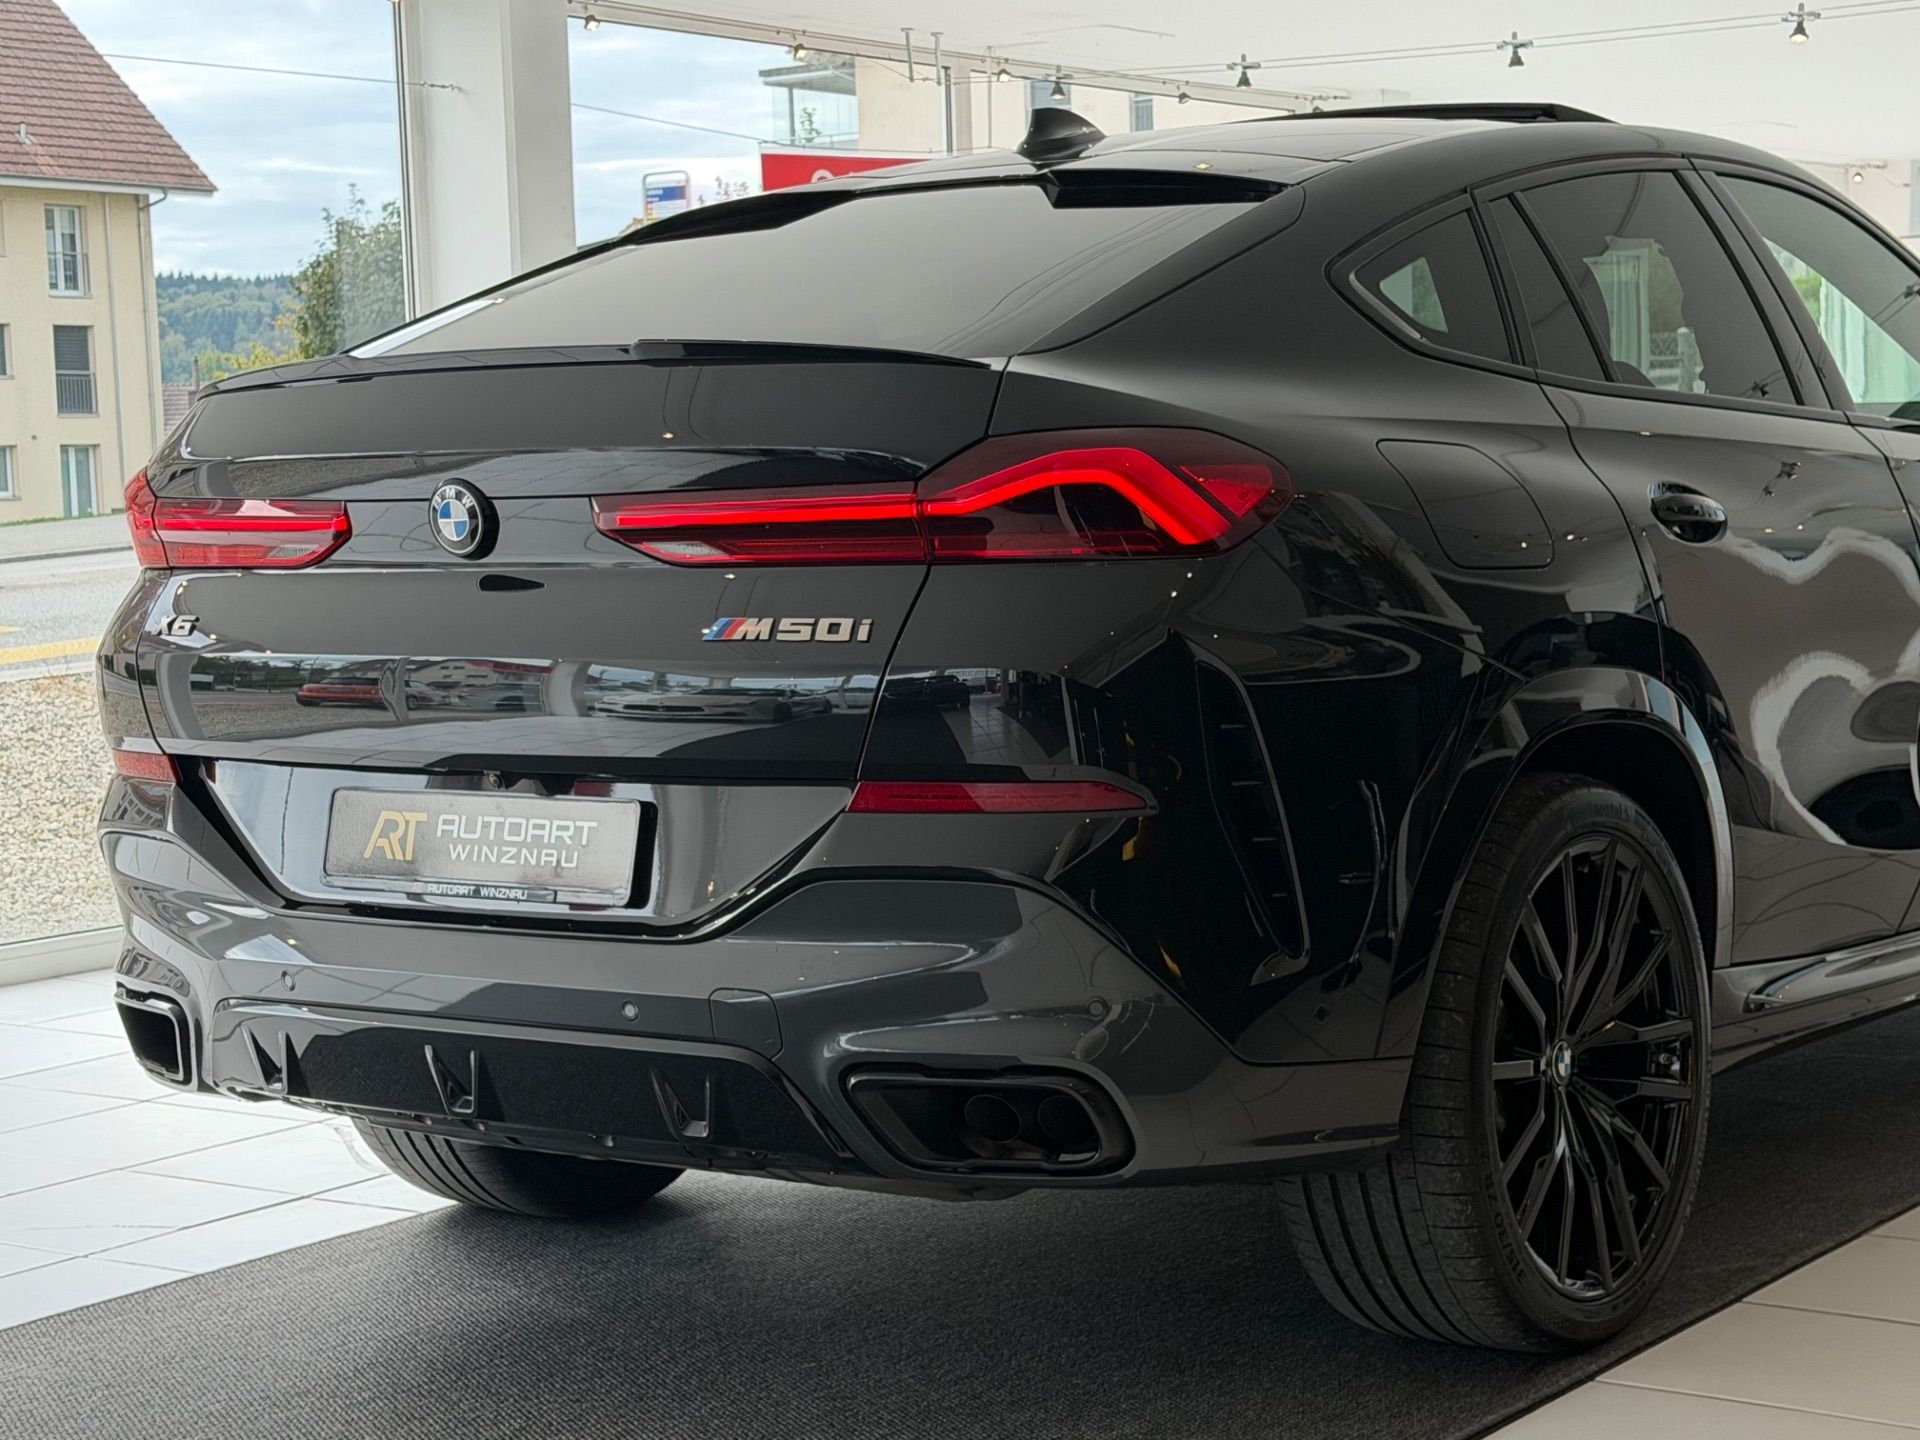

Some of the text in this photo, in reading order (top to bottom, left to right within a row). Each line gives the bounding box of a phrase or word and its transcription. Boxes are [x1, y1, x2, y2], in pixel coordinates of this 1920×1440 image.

[433, 487, 474, 511] BMW
[150, 614, 199, 637] X6
[436, 814, 598, 846] AUTOART
[449, 844, 579, 868] WINZNAU
[427, 882, 476, 897] AUTOART
[480, 886, 529, 900] WINZNAU
